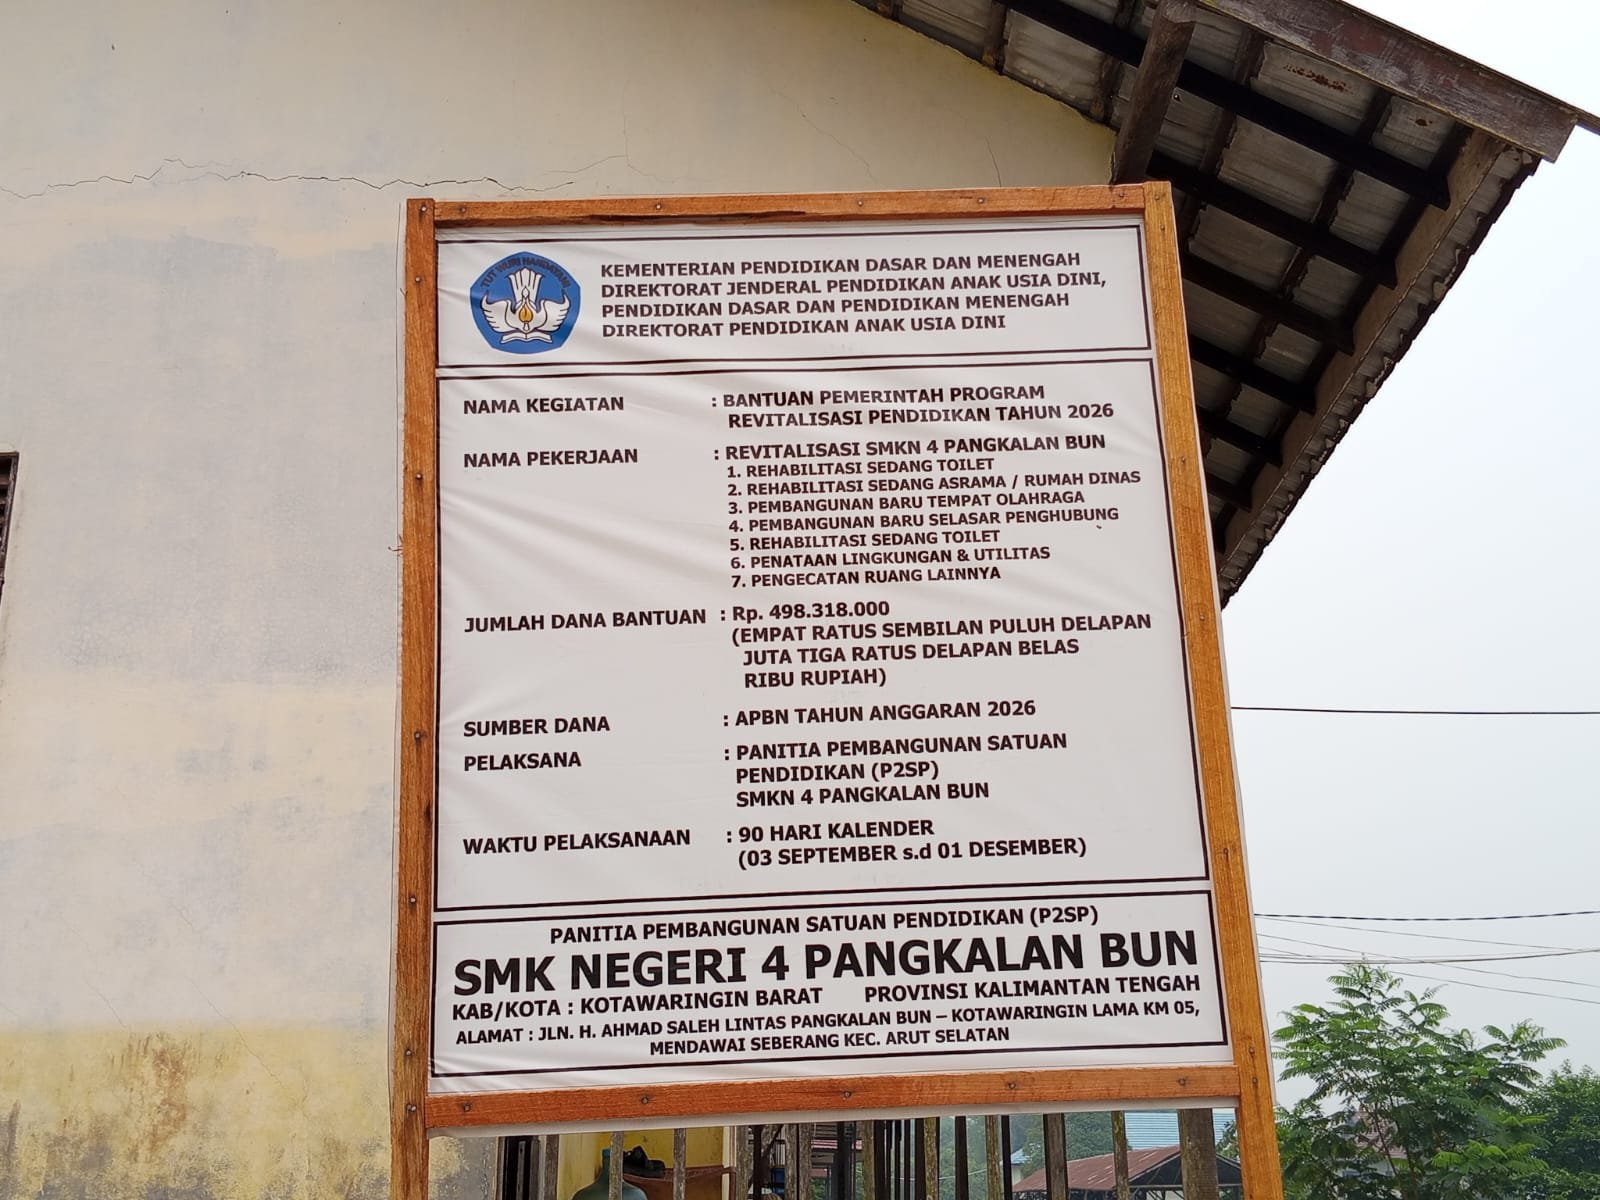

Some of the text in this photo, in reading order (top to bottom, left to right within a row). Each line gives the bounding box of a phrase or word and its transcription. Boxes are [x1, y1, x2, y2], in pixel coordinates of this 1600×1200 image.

[600, 251, 1081, 278] KEMENTERIAN PENDIDIKAN DASAR DAN MENENGAH
[481, 269, 497, 288] TUT
[600, 271, 1107, 299] DIREKTORAT JENDERAL PENDIDIKAN ANAK USIA DINI,
[601, 292, 1070, 319] PENDIDIKAN DASAR DAN PENDIDIKAN MENENGAH
[602, 314, 1007, 338] DIREKTORAT PENDIDIKAN ANAK USIA DINI
[463, 395, 625, 416] NAMA KEGIATAN
[722, 389, 815, 408] BANTUAN
[819, 387, 945, 406] PEMERINTAH
[949, 384, 1046, 403] PROGRAM
[727, 402, 1115, 430] REVITALISASI PENDIDIKAN TAHUN 2026
[463, 447, 639, 469] NAMA PEKERJAAN
[724, 441, 862, 461] REVITALISASI
[865, 439, 922, 457] SMKN
[925, 439, 940, 455] 4
[943, 435, 1060, 454] PANGKALAN
[1064, 433, 1106, 450] BUN
[726, 457, 996, 479] 1. REHABILITASI SEDANG TOILET
[727, 470, 1142, 497] 2. REHABILITASI SEDANG ASRAMA / RUMAH DINAS
[727, 490, 1086, 516] 3. PEMBANGUNAN BARU TEMPAT OLAHRAGA
[727, 506, 1120, 534] 4. PEMBANGUNAN BARU SELASAR PENGHUBUNG
[729, 528, 1001, 552] 5. REHABILITASI SEDANG TOILET
[729, 545, 1051, 570] 6. PENATAAN LINGKUNGAN & UTILITAS
[730, 565, 1002, 589] 7. PENGECATAN RUANG LAINNYA
[463, 608, 707, 634] JUMLAH DANA BANTUAN
[731, 605, 764, 625] Rp.
[768, 600, 891, 621] 498.318.000
[731, 613, 1152, 648] (EMPAT RATUS SEMBILAN PULUH DELAPAN
[742, 637, 1080, 667] JUTA TIGA RATUS DELAPAN BELAS
[744, 667, 887, 689] RIBU RUPIAH)
[734, 708, 790, 727] APBN
[793, 705, 864, 725] TAHUN
[868, 700, 982, 722] ANGGARAN
[986, 698, 1037, 718] 2026
[462, 715, 611, 738] SUMBER DANA
[736, 741, 823, 761] PANITIA
[826, 735, 982, 758] PEMBANGUNAN
[986, 732, 1068, 752] SATUAN
[463, 750, 583, 773] PELAKSANA
[735, 759, 940, 785] PENDIDIKAN (P2SP)
[735, 781, 990, 809] SMKN 4 PANGKALAN BUN
[462, 828, 691, 856] WAKTU PELAKSANAAN
[737, 825, 765, 844] 90
[769, 823, 823, 843] HARI
[827, 818, 936, 840] KALENDER
[737, 836, 1087, 872] (03 SEPTEMBER s.d 01 DESEMBER)
[549, 904, 1099, 945] PANITIA PEMBANGUNAN SATUAN PENDIDIKAN (P2SP)
[453, 929, 1199, 997] SMK NEGERI 4 PANGKALAN BUN
[864, 973, 1201, 1004] PROVINSI KALIMANTAN TENGAH
[451, 998, 562, 1023] KAB/KOTA
[580, 989, 750, 1015] KOTAWARINGIN
[754, 986, 824, 1007] BARAT
[455, 1027, 525, 1046] ALAMAT
[537, 1025, 575, 1042] JLN.
[578, 1024, 597, 1040] H.
[600, 1020, 664, 1039] AHMAD
[666, 1017, 721, 1036] SALEH
[724, 1015, 788, 1033] LINTAS
[790, 1010, 892, 1030] PANGKALAN
[895, 1008, 932, 1026] BUN
[951, 1003, 1089, 1023] KOTAWARINGIN
[1091, 1001, 1140, 1018] LAMA
[1142, 1000, 1170, 1016] KM
[1173, 999, 1201, 1018] 05,
[649, 1025, 1010, 1057] MENDAWAI SEBERANG KEC. ARUT SELATAN
